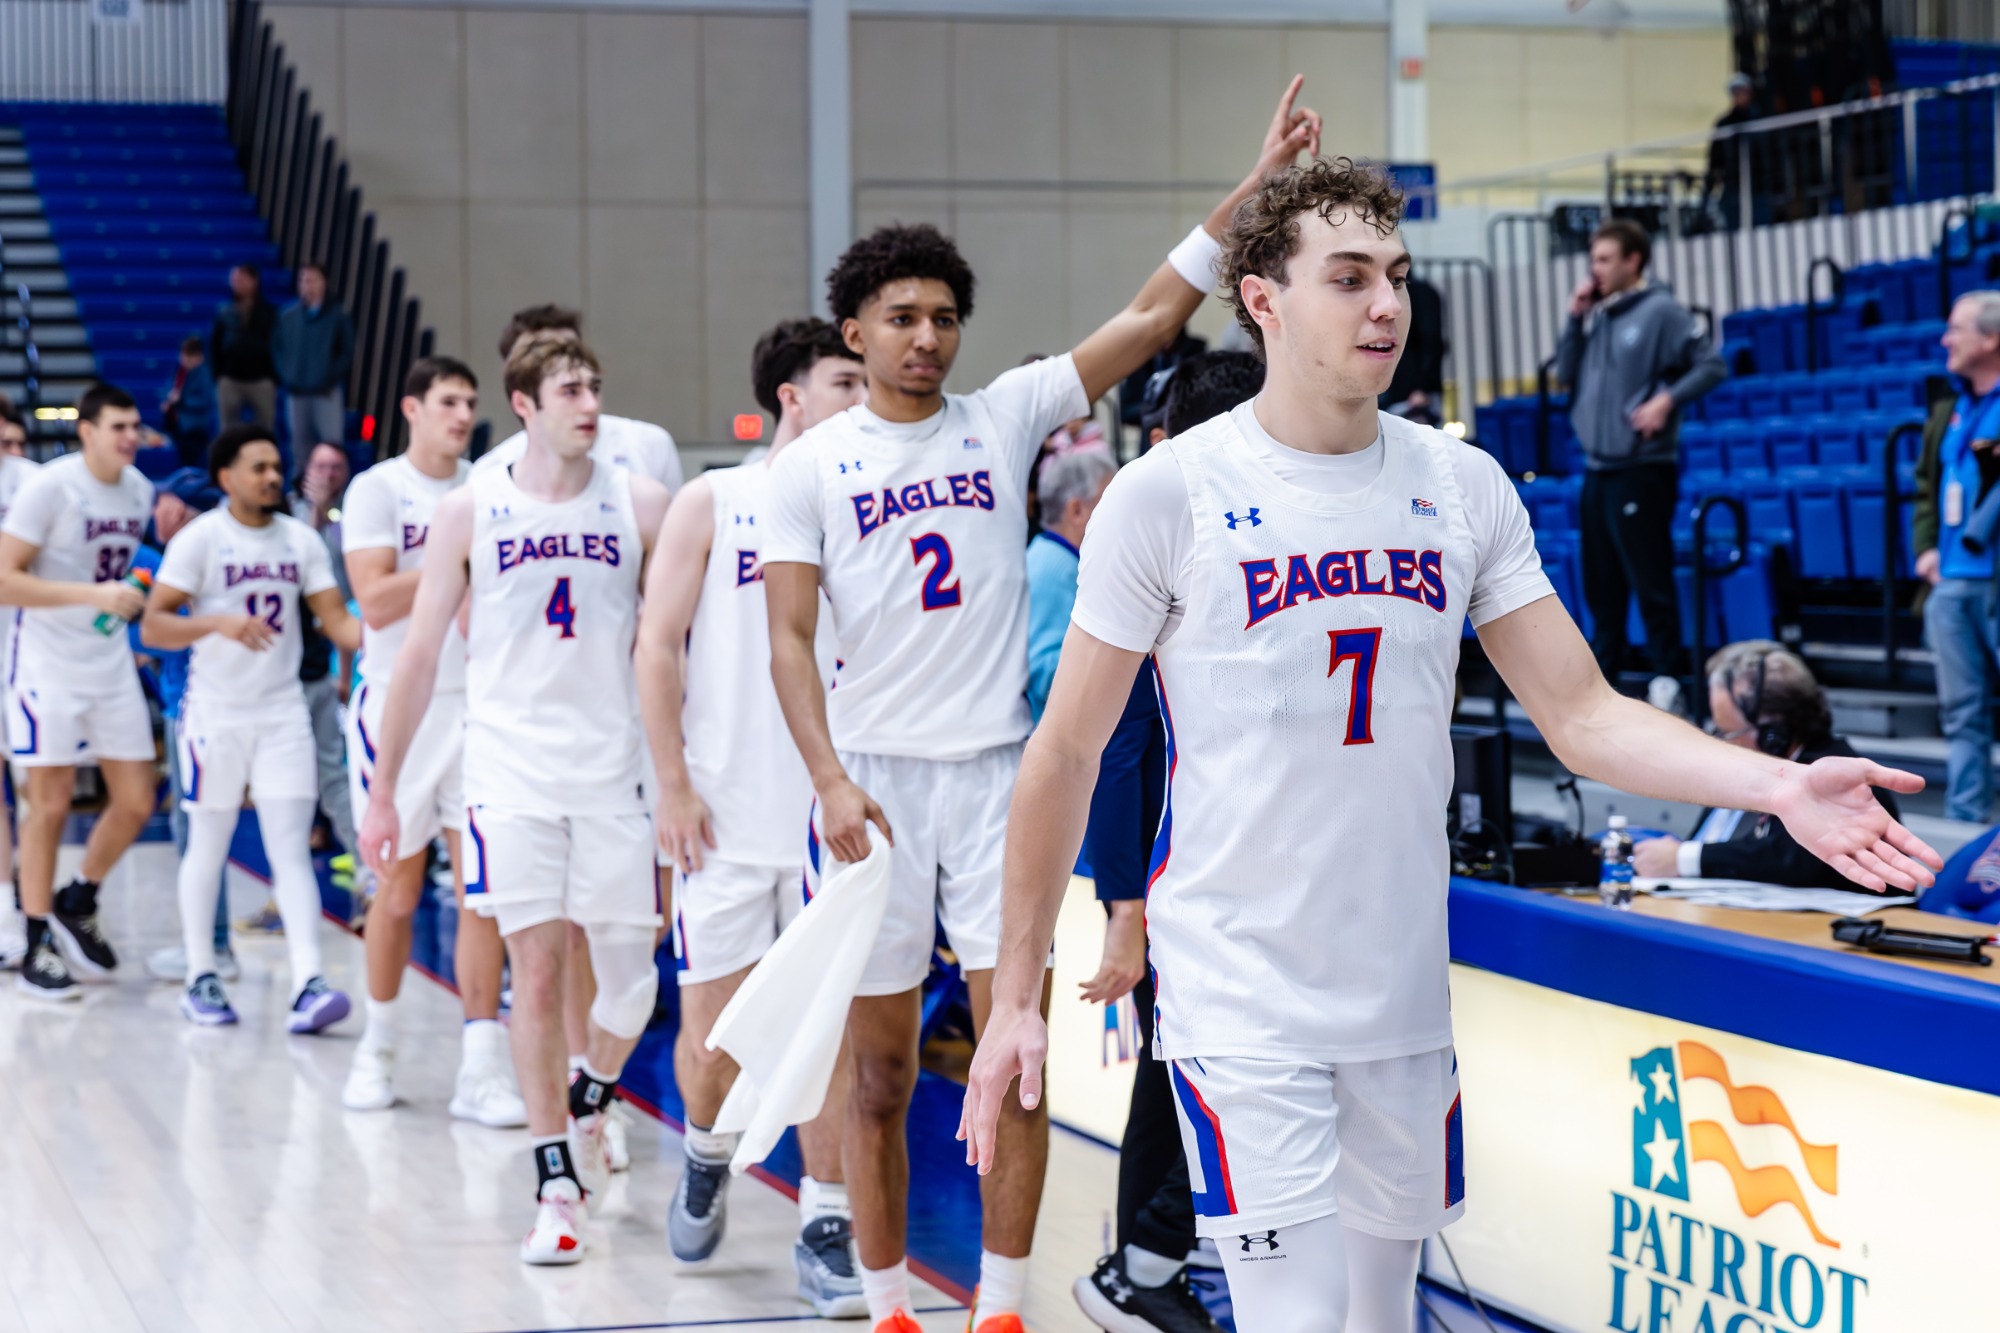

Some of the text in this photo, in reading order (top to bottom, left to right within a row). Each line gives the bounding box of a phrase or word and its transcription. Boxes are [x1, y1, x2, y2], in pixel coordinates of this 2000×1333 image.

[850, 470, 995, 541] EAGLES
[225, 563, 299, 591] EAGLES
[496, 533, 621, 574] EAGLES
[910, 532, 961, 611] 2
[1239, 549, 1447, 631] EAGLES
[545, 576, 576, 639] 4
[1327, 627, 1383, 745] 7
[1608, 1189, 1869, 1333] PATRIOT
